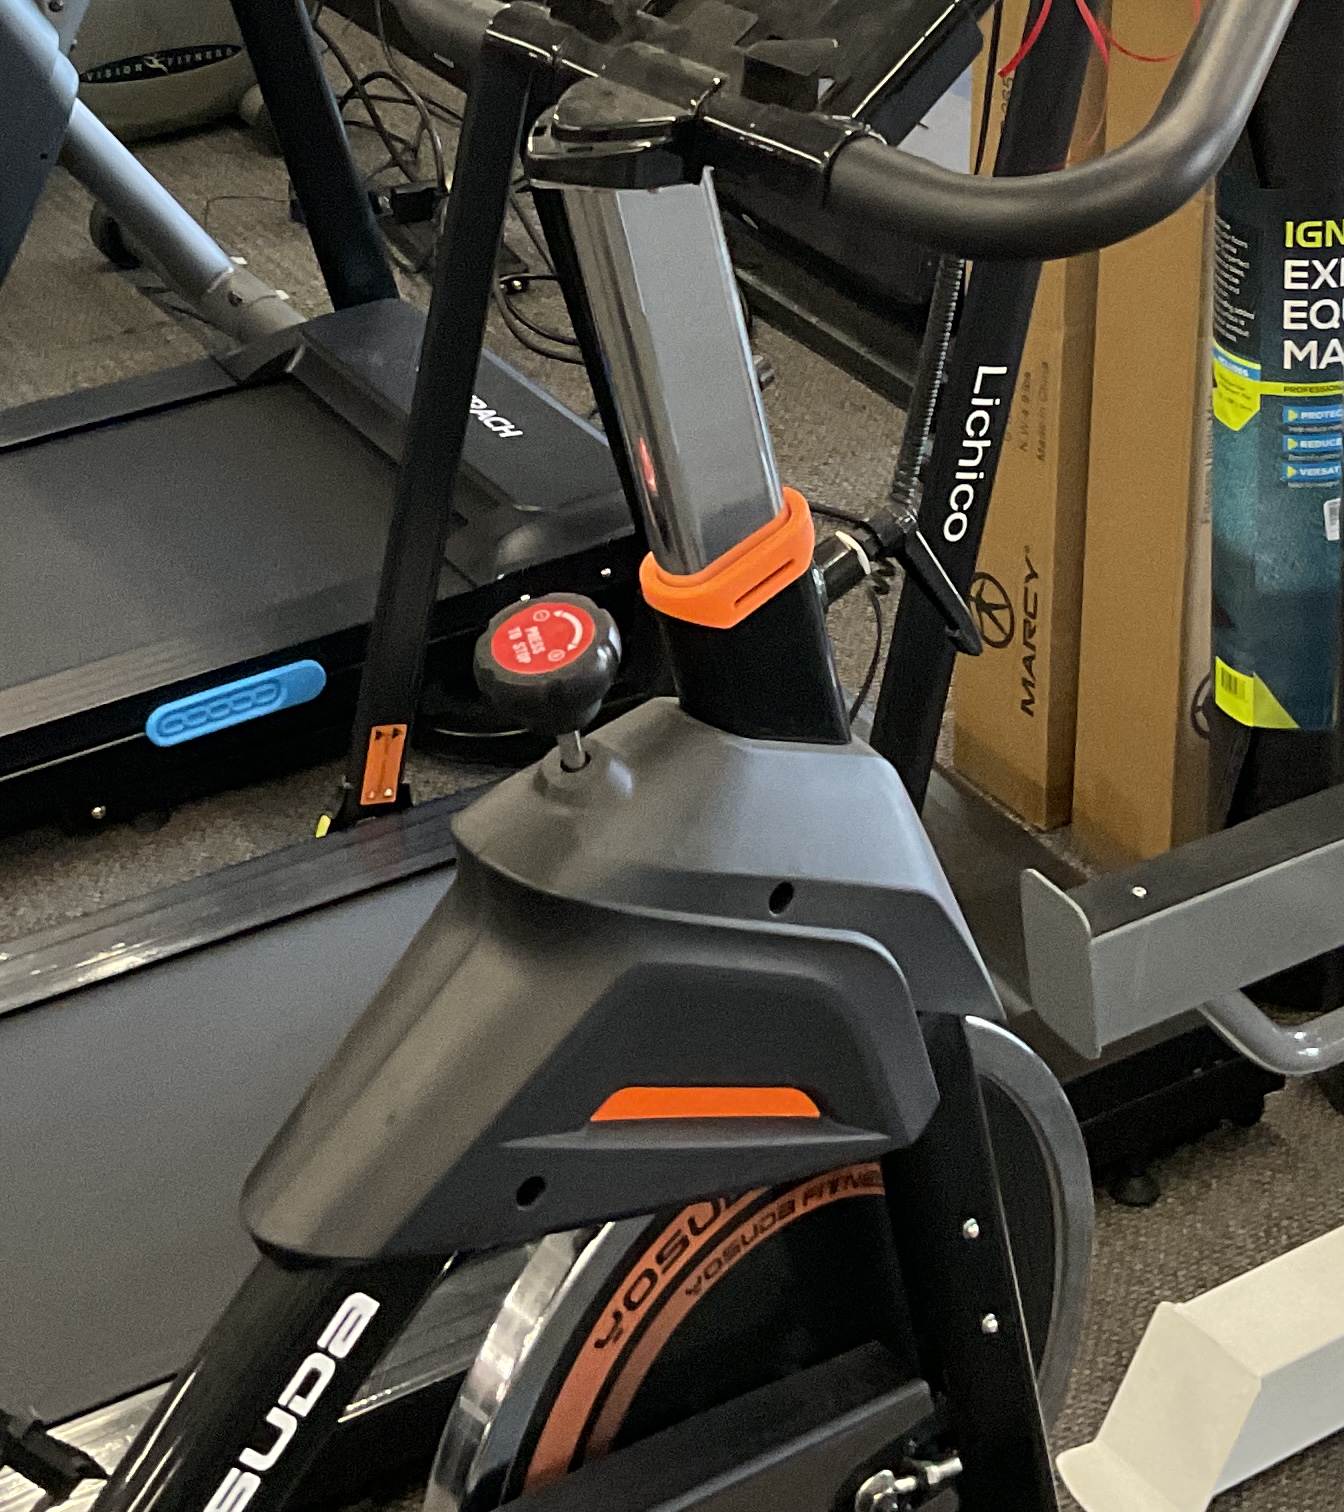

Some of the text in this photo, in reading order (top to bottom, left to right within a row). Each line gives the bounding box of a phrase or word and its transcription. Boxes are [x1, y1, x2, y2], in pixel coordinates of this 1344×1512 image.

[86, 47, 233, 82] VISION FITNESS
[942, 365, 1008, 545] Lichico
[1020, 554, 1039, 717] MARCY
